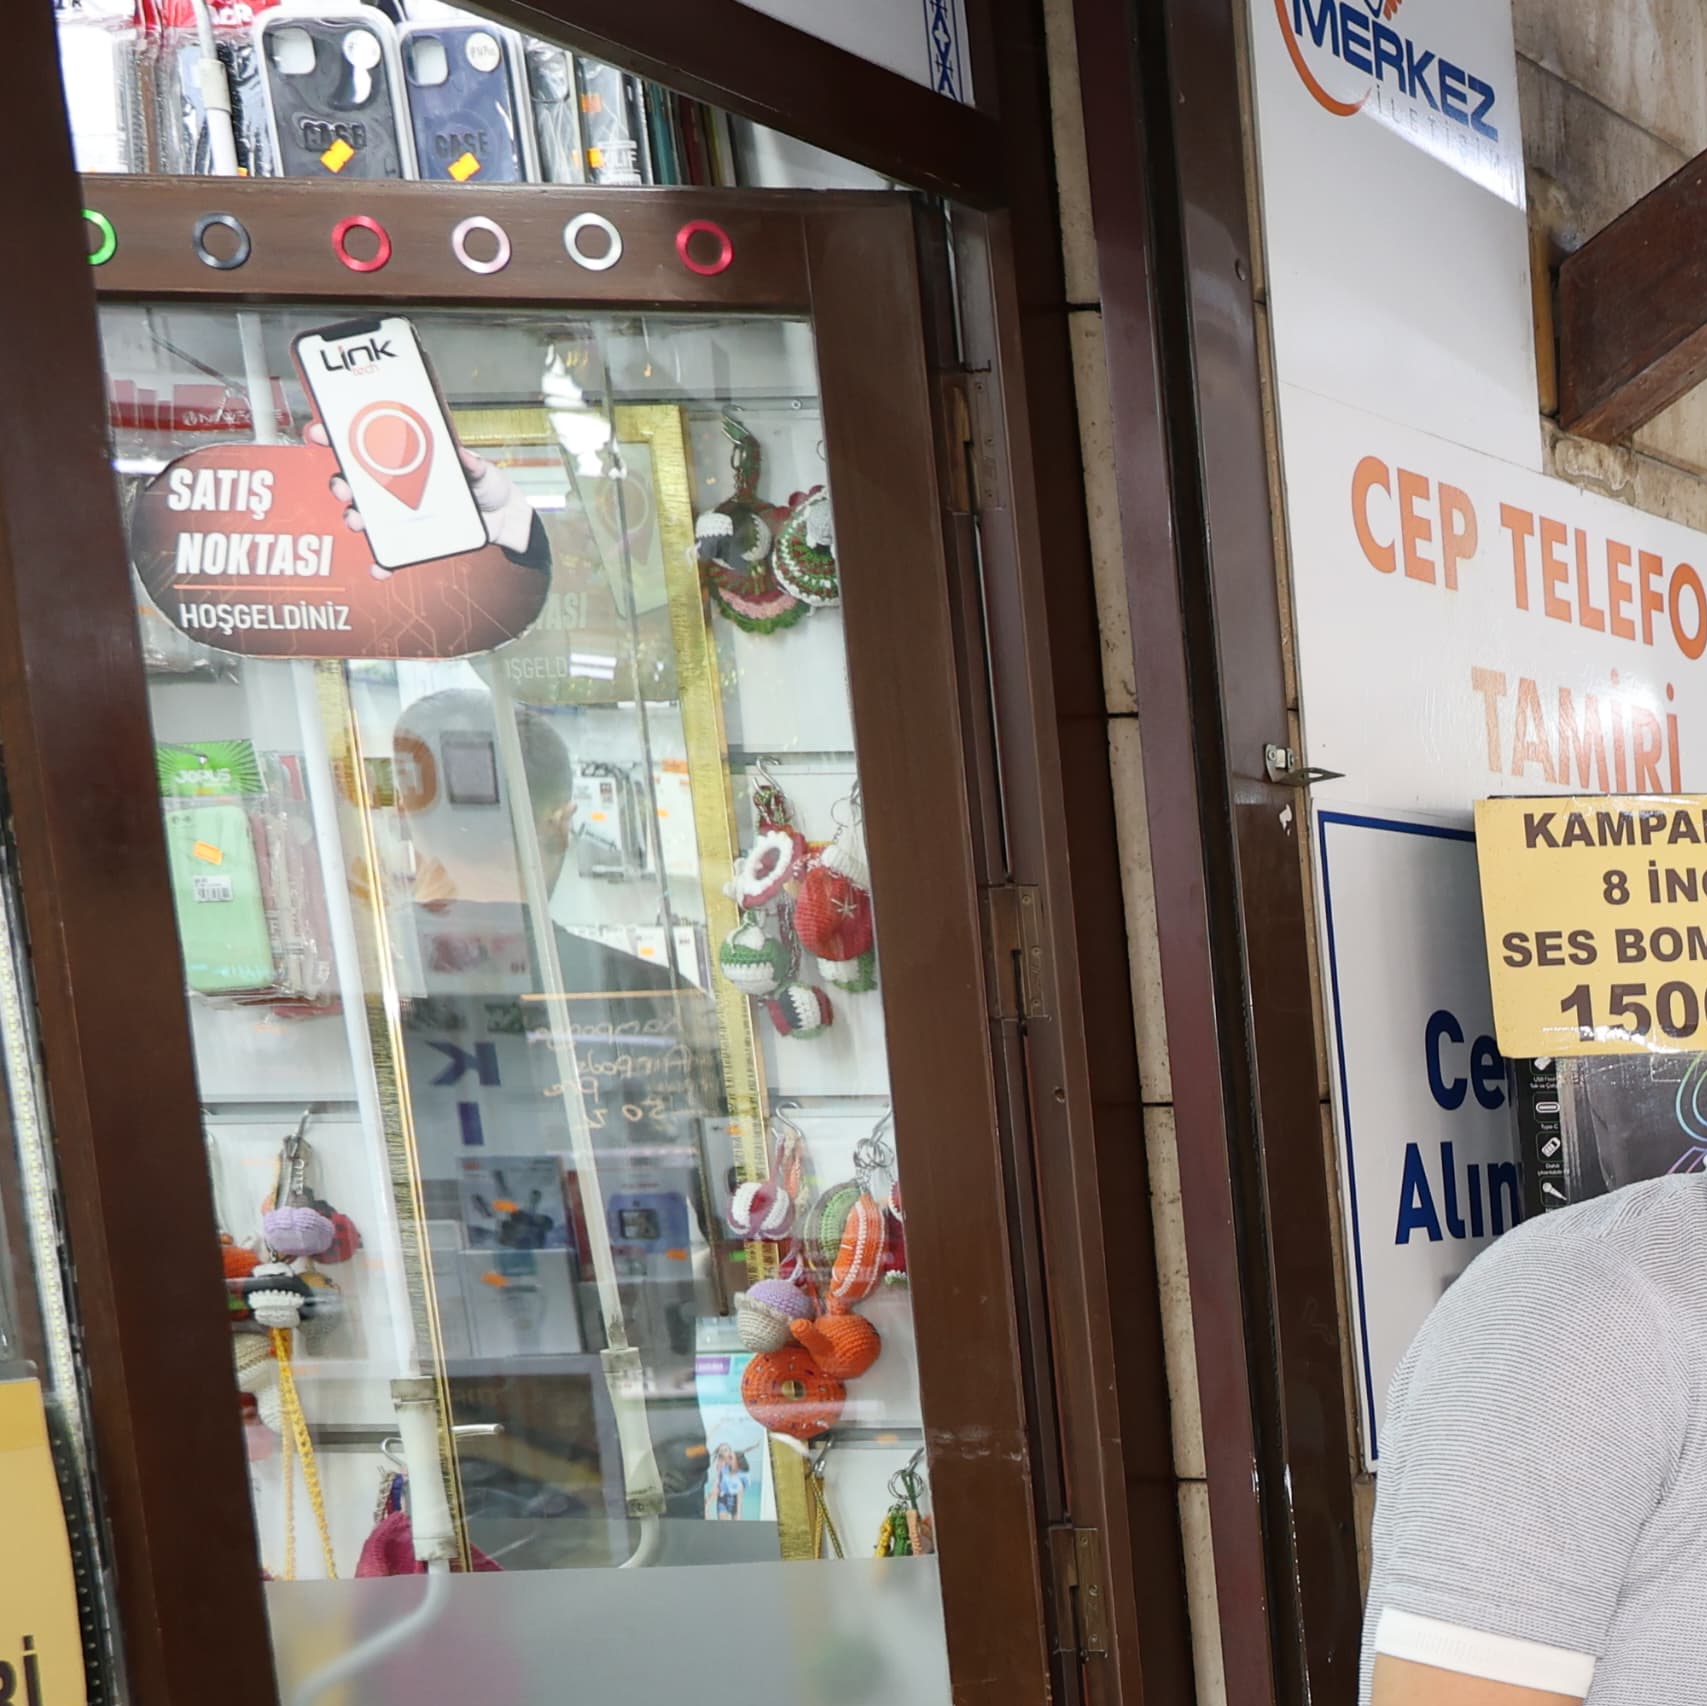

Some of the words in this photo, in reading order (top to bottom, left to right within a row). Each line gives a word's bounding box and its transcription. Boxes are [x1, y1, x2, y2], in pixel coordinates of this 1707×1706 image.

[1293, 0, 1499, 141] MERKEZ
[320, 338, 398, 371] Link
[167, 467, 274, 520] SATIŞ
[1351, 454, 1479, 591] CEP
[175, 532, 334, 577] NOKTASI
[180, 601, 353, 635] HOŞGELDİNİZ
[1471, 665, 1683, 794] TAMİRİ
[1601, 869, 1631, 906] 8
[1501, 929, 1598, 970] SES
